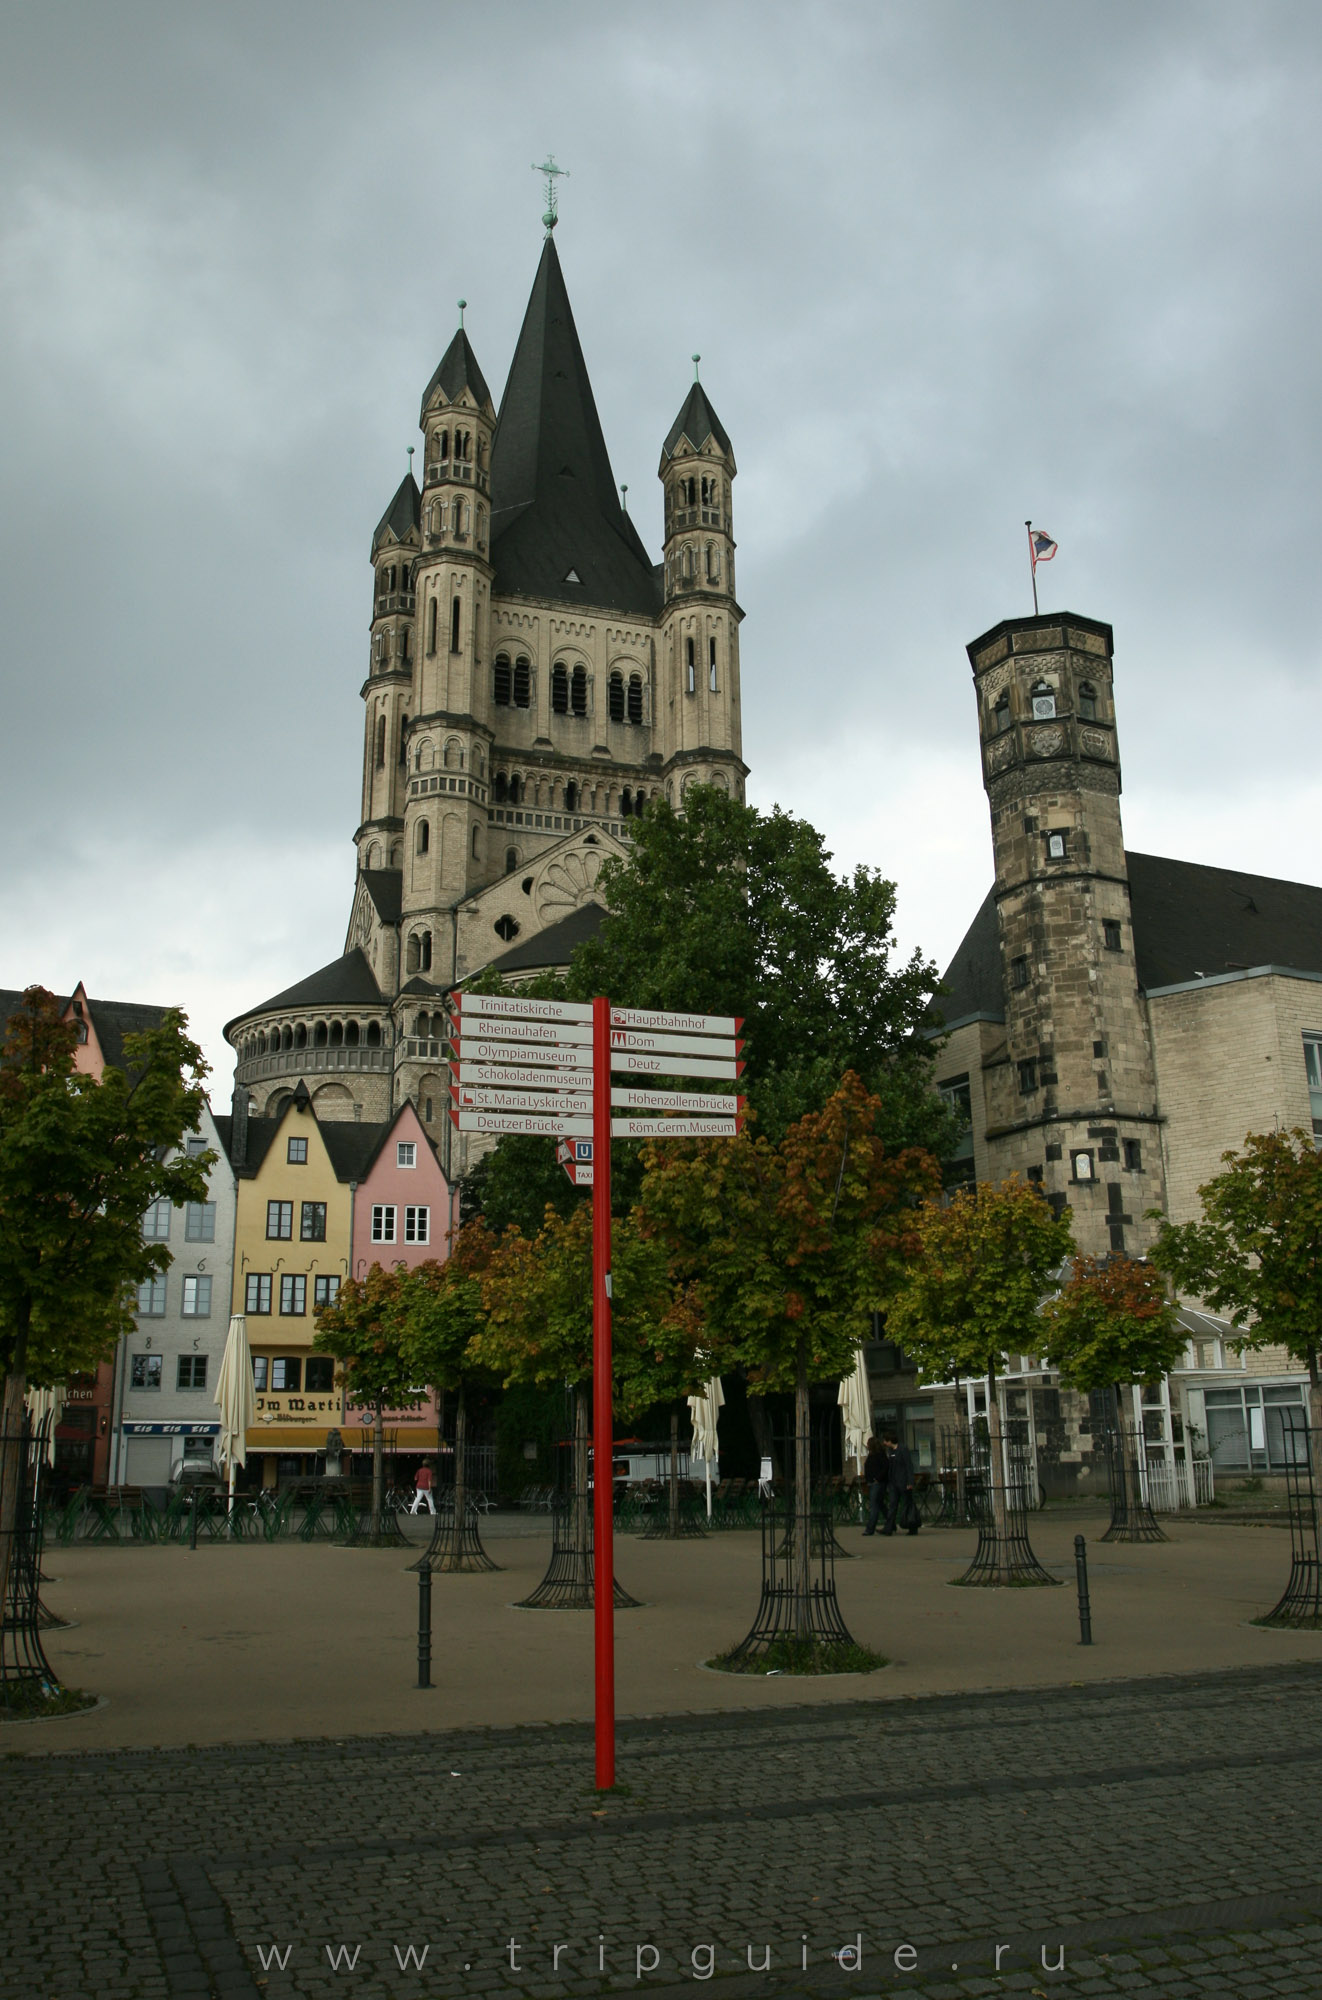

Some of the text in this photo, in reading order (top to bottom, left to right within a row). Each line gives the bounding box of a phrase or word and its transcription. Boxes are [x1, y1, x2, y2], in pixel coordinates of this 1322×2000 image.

[479, 999, 562, 1017] Trinitatiskirche
[627, 1013, 706, 1030] Hauptbahnhof
[479, 1022, 557, 1039] Rheinauhafen
[628, 1035, 655, 1047] Dom
[478, 1045, 577, 1063] Olympiamuseum
[628, 1057, 661, 1071] Deutz
[478, 1068, 592, 1086] Schokoladenmuseum
[477, 1092, 587, 1110] St. Maria Lyskirchen
[628, 1093, 734, 1110] Hohenzollernbrücke
[477, 1117, 564, 1131] Deutzer Brücke
[580, 1145, 589, 1157] U
[577, 1171, 592, 1179] TAXI
[133, 1425, 211, 1433] EIS EIS EIS
